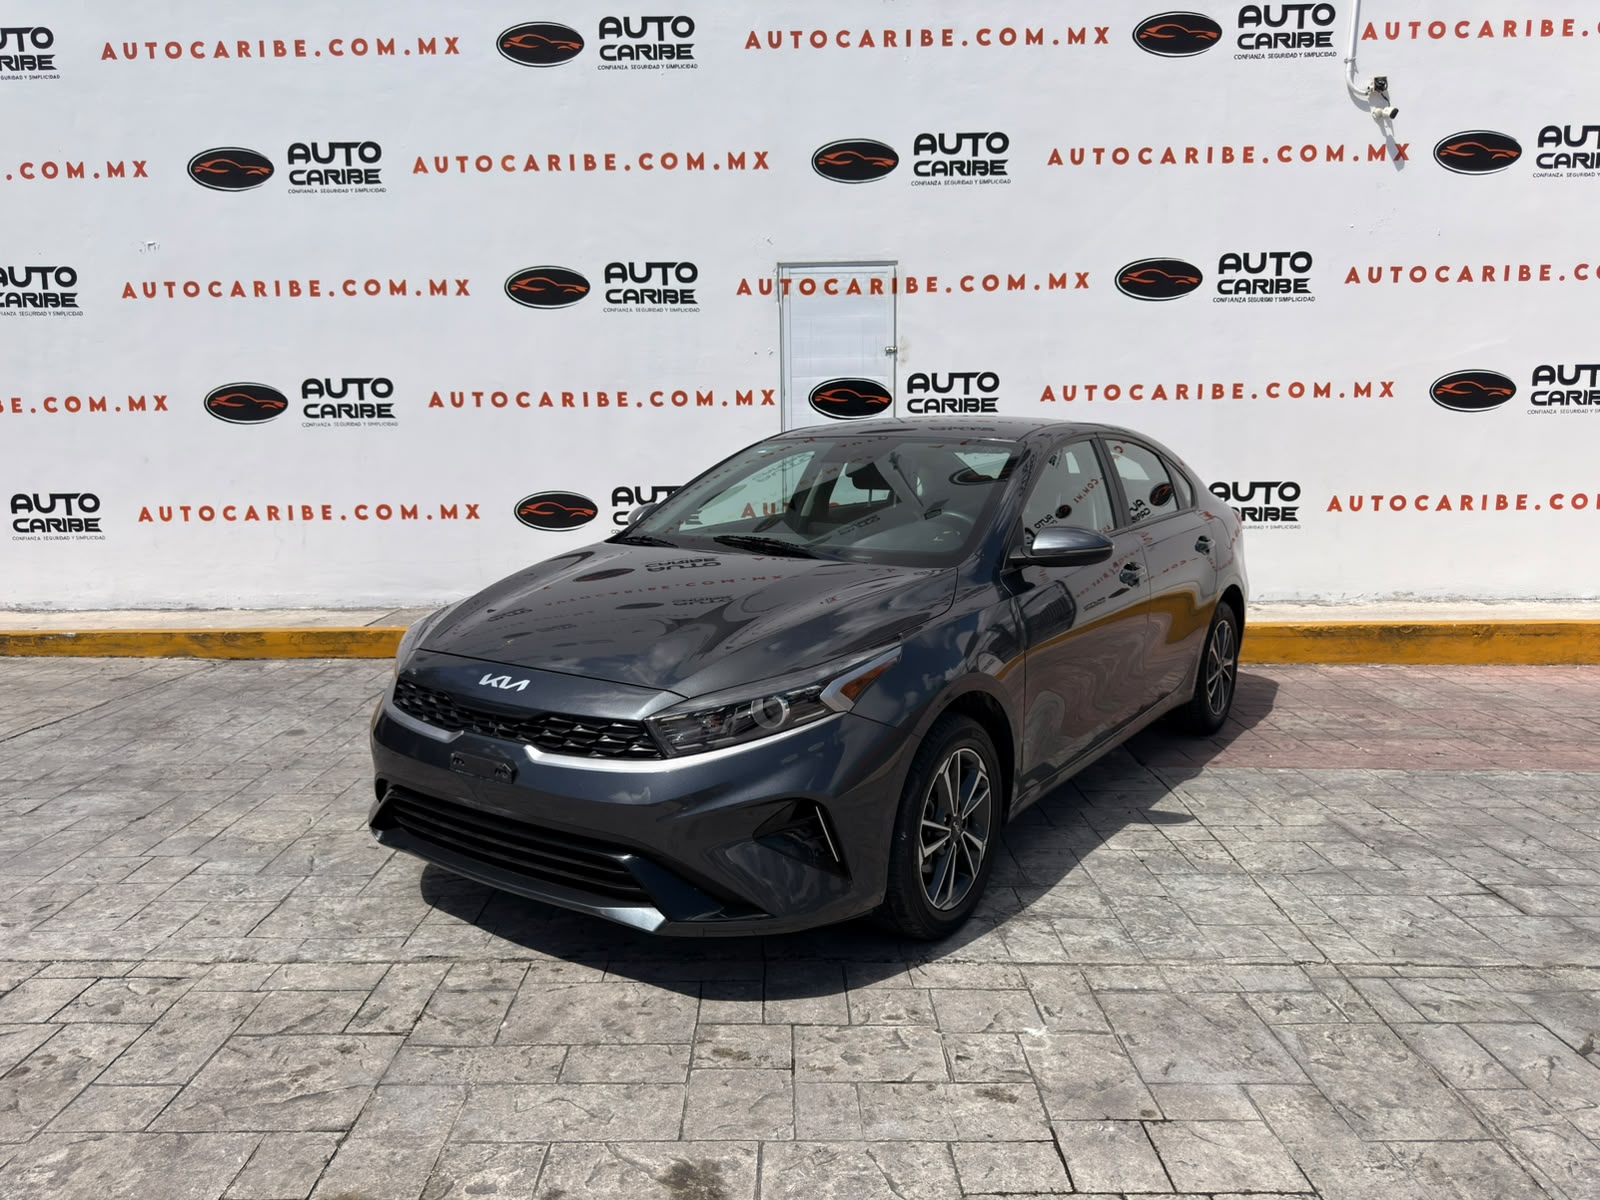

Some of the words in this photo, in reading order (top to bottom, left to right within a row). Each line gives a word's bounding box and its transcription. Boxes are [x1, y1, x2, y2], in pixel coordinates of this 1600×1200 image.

[1238, 3, 1335, 29] AUTO
[599, 16, 694, 41] AUTO
[744, 28, 1109, 49] AUTOCARIBE.COM.MX
[1361, 20, 1600, 41] AUTOCARIBE.
[101, 37, 460, 60] AUTOCARIBE.COM.MX
[1238, 31, 1334, 50] CARIBE
[600, 44, 695, 61] CARIBE
[288, 142, 381, 166] AUTO
[914, 132, 1009, 157] AUTO
[1047, 143, 1409, 165] AUTOCARIBE.COM.MX
[412, 152, 769, 175] AUTOCARIBE.COM.MX
[914, 159, 1008, 177] CARIBE
[1537, 153, 1600, 169] CARI
[289, 168, 382, 186] CARIBE
[605, 262, 697, 286] AUTO
[1219, 252, 1312, 276] AUTO
[1344, 263, 1600, 285] AUTOCARIBE.C
[121, 279, 470, 299] AUTOCARIBE.COM.MX
[736, 271, 1091, 296] AUTOCARIBE.COM.MX
[1217, 277, 1312, 295] CARIBE
[606, 288, 698, 304] CARIBE
[302, 378, 393, 401] AUTO
[907, 371, 999, 396] AUTO
[1040, 382, 1394, 402] AUTOCARIBE.COM.MX
[428, 389, 776, 409] AUTOCARIBE.COM.MX
[907, 397, 999, 414] CARIBE
[304, 402, 396, 419] CARIBE
[1209, 481, 1301, 505] AUTO
[11, 493, 100, 516] AUTO
[138, 504, 480, 523] AUTOCARIBE.COM.MX
[1326, 494, 1600, 513] AUTOCARIBE.CO
[1231, 506, 1300, 522] RIBE
[13, 517, 102, 533] CARIBE
[478, 673, 531, 692] KIA
